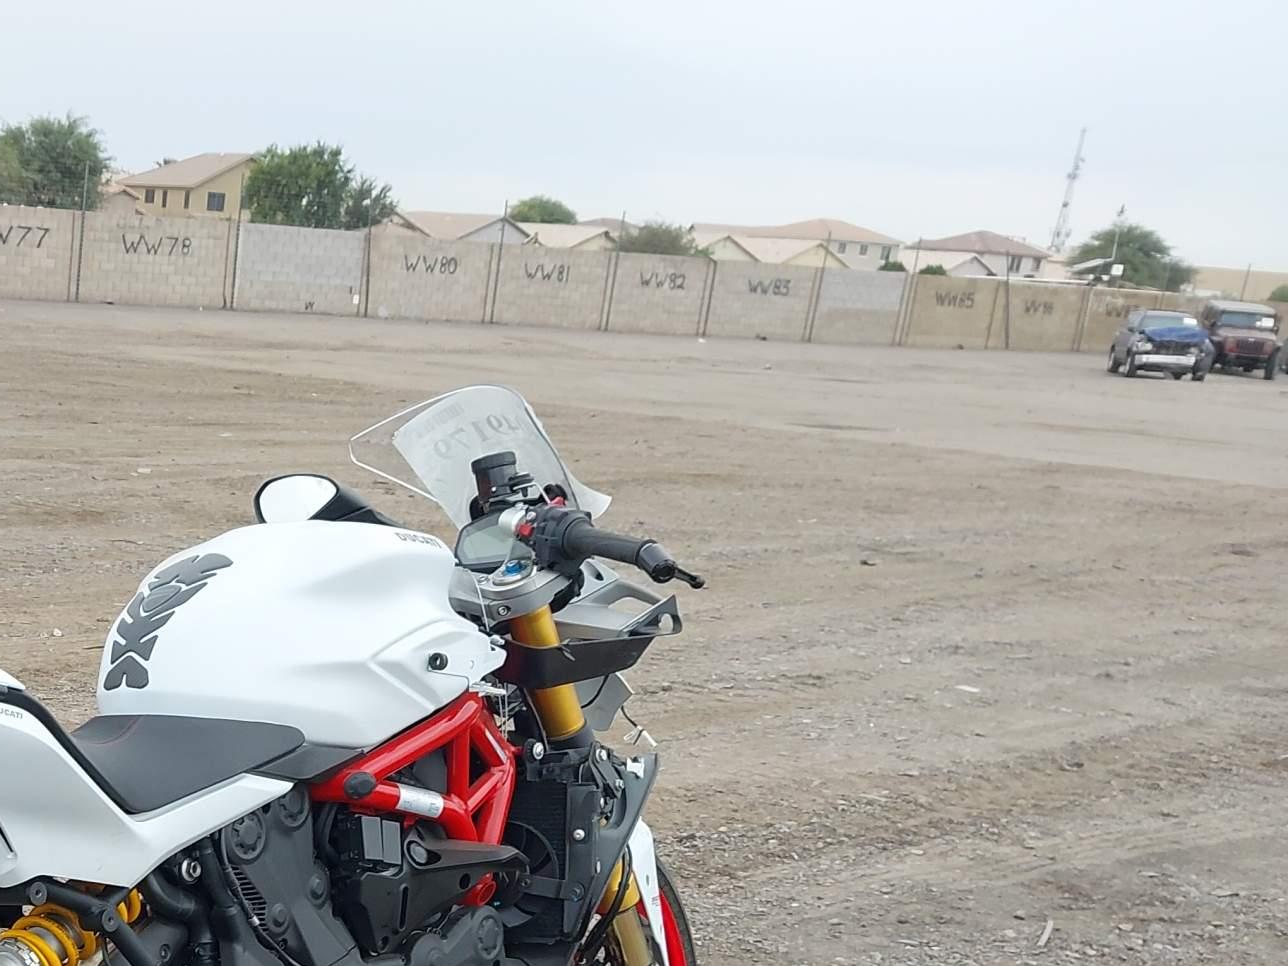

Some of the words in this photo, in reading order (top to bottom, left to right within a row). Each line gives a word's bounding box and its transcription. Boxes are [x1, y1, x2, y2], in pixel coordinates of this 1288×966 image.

[122, 233, 193, 256] WW78
[403, 254, 459, 275] WW80
[523, 263, 571, 283] WW81
[639, 271, 686, 291] WW82
[394, 532, 442, 549] DUCATI
